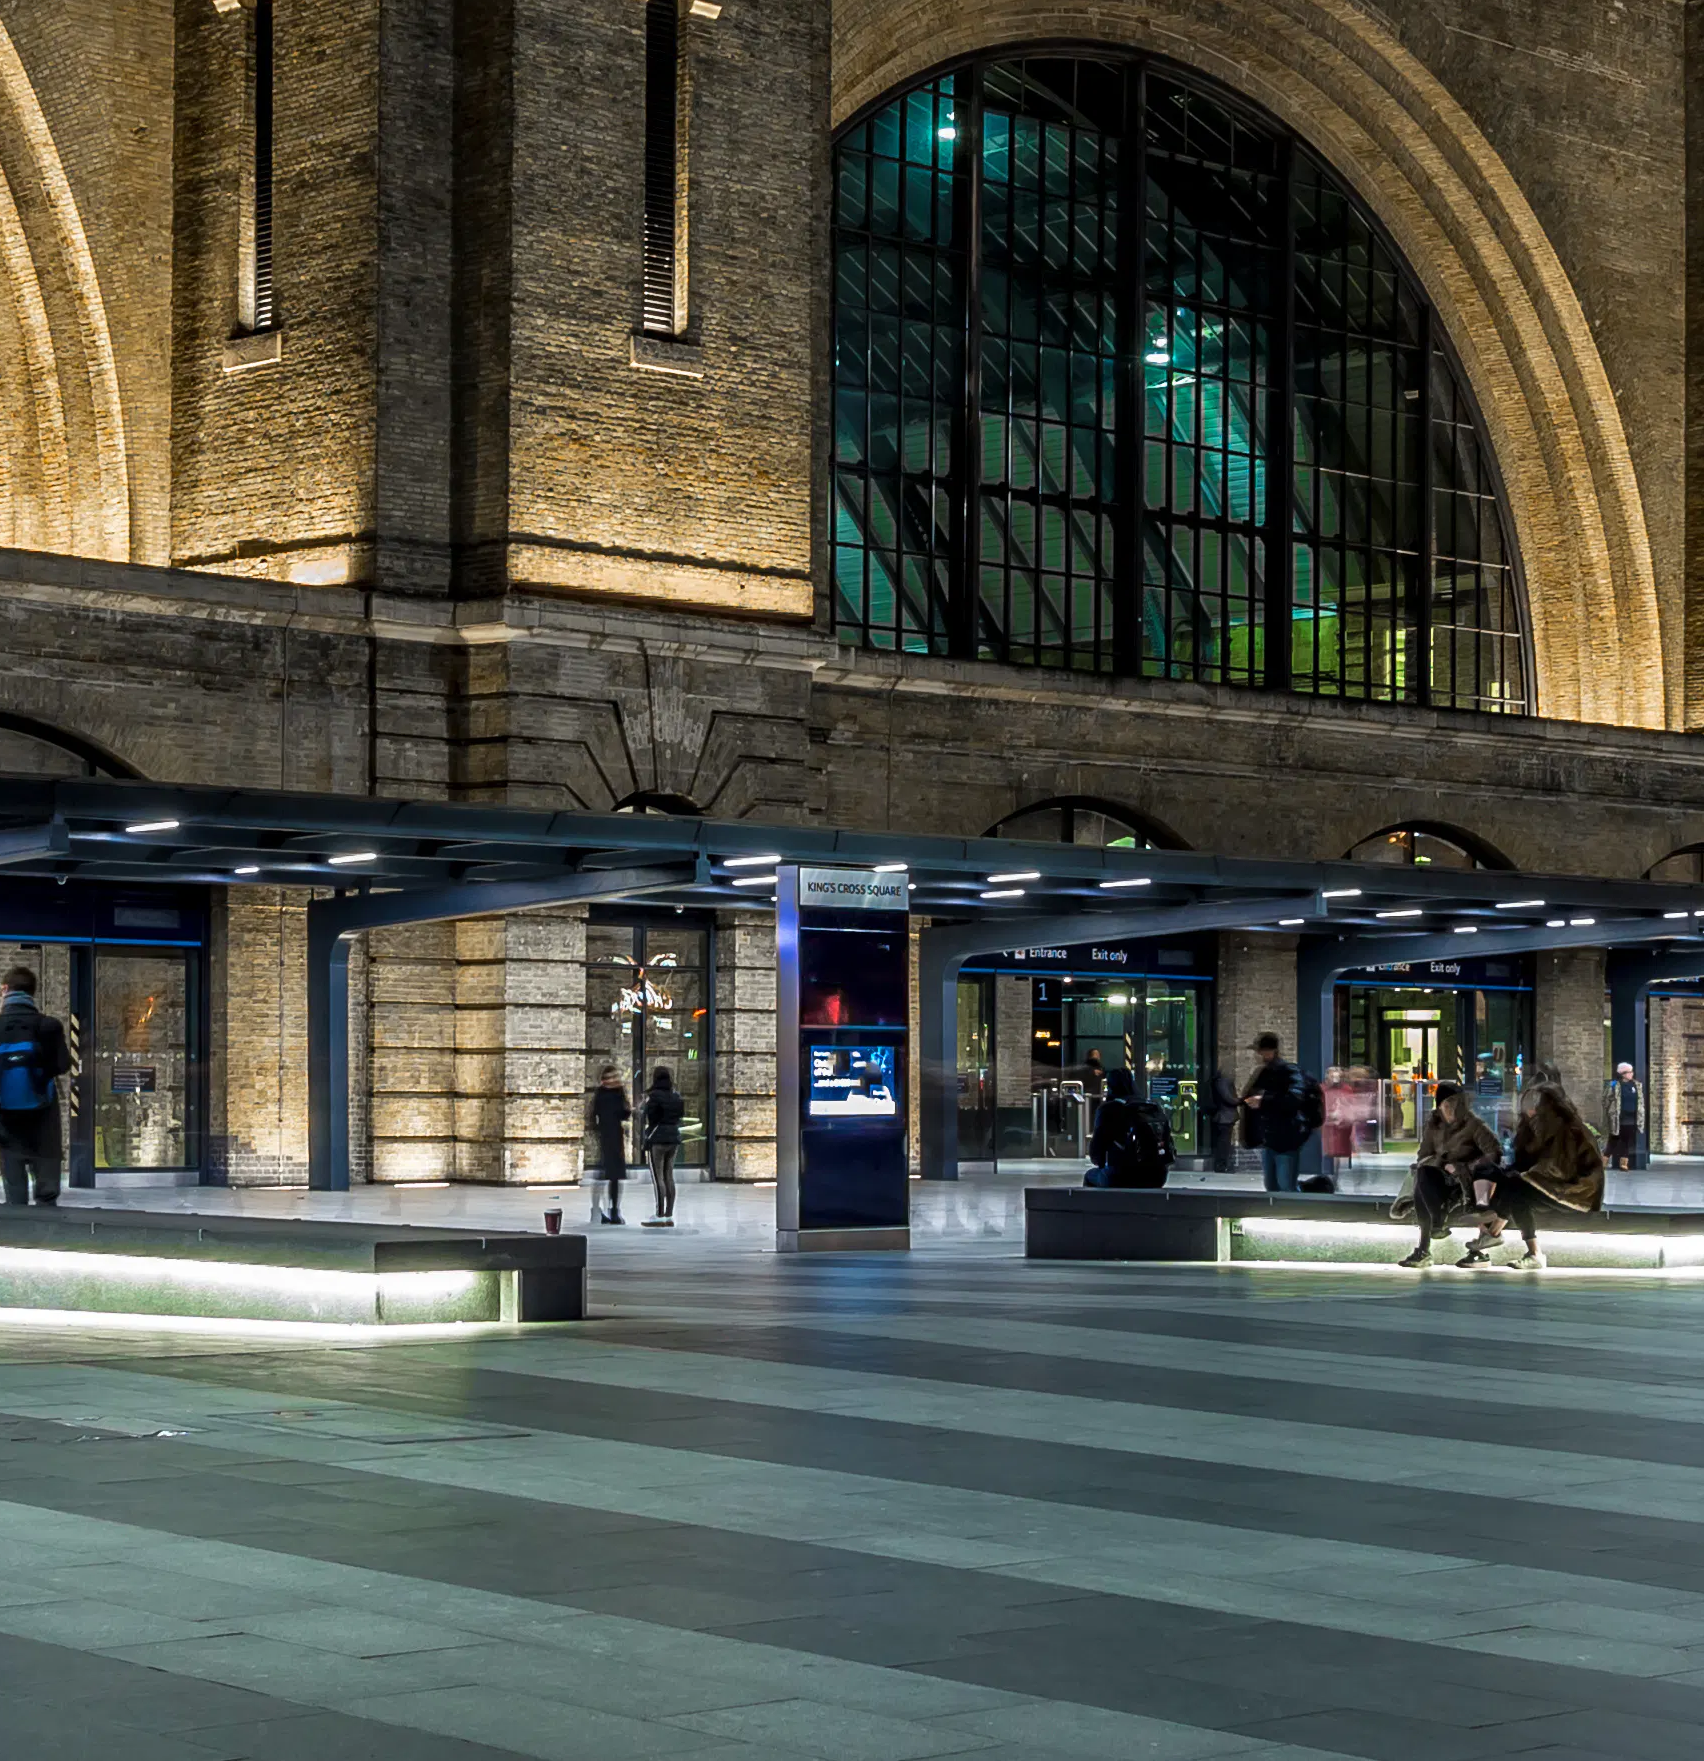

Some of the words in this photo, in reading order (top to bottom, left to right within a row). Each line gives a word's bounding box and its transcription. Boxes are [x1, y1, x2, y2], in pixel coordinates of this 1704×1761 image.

[807, 882, 836, 894] KING'S
[838, 883, 866, 895] CROSS
[867, 884, 901, 897] SQUARE
[1029, 948, 1068, 959] Entrance
[1092, 948, 1108, 961] Exit
[1109, 950, 1128, 963] only
[1430, 961, 1444, 973] Exit
[1446, 962, 1461, 976] only
[1038, 982, 1049, 1002] 1
